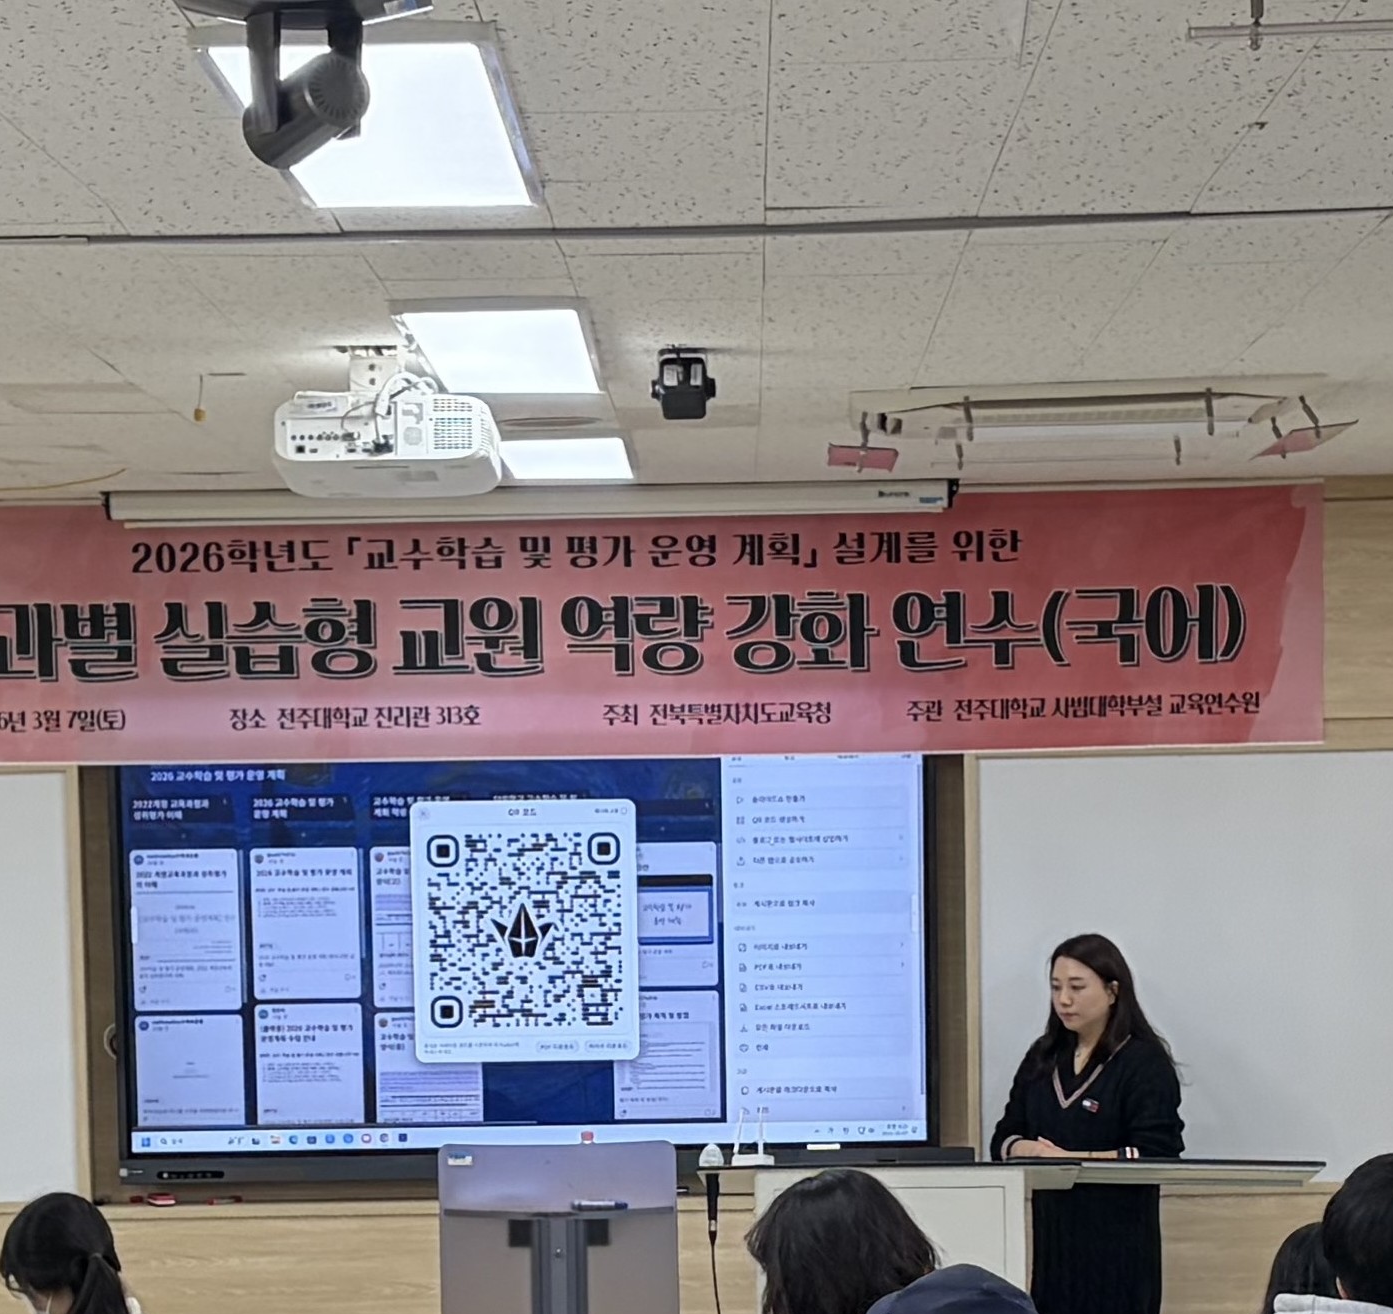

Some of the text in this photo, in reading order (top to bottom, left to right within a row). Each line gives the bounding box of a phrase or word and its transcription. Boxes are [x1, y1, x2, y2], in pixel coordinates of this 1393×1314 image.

[132, 529, 1021, 573] 2026학년도 「교수학습 및 평가 운영 계획」 설계를 위한
[153, 597, 378, 680] 실습형
[392, 596, 545, 676] 교원
[560, 593, 714, 677] 역량
[726, 590, 881, 672] 강화
[892, 583, 1246, 670] 연수(국어)
[34, 710, 60, 732] 3월
[68, 710, 125, 732] 7일(토)
[231, 709, 265, 730] 장소
[278, 707, 367, 729] 전주대학교
[376, 706, 429, 728] 진리관
[437, 705, 480, 725] 313호
[604, 704, 638, 725] 주최
[651, 702, 830, 725] 전북특별자치도교육청
[908, 700, 942, 722] 주관
[955, 698, 1046, 721] 전주대학교
[1052, 695, 1162, 718] 사범대학부설
[1170, 692, 1259, 714] 교육연수원
